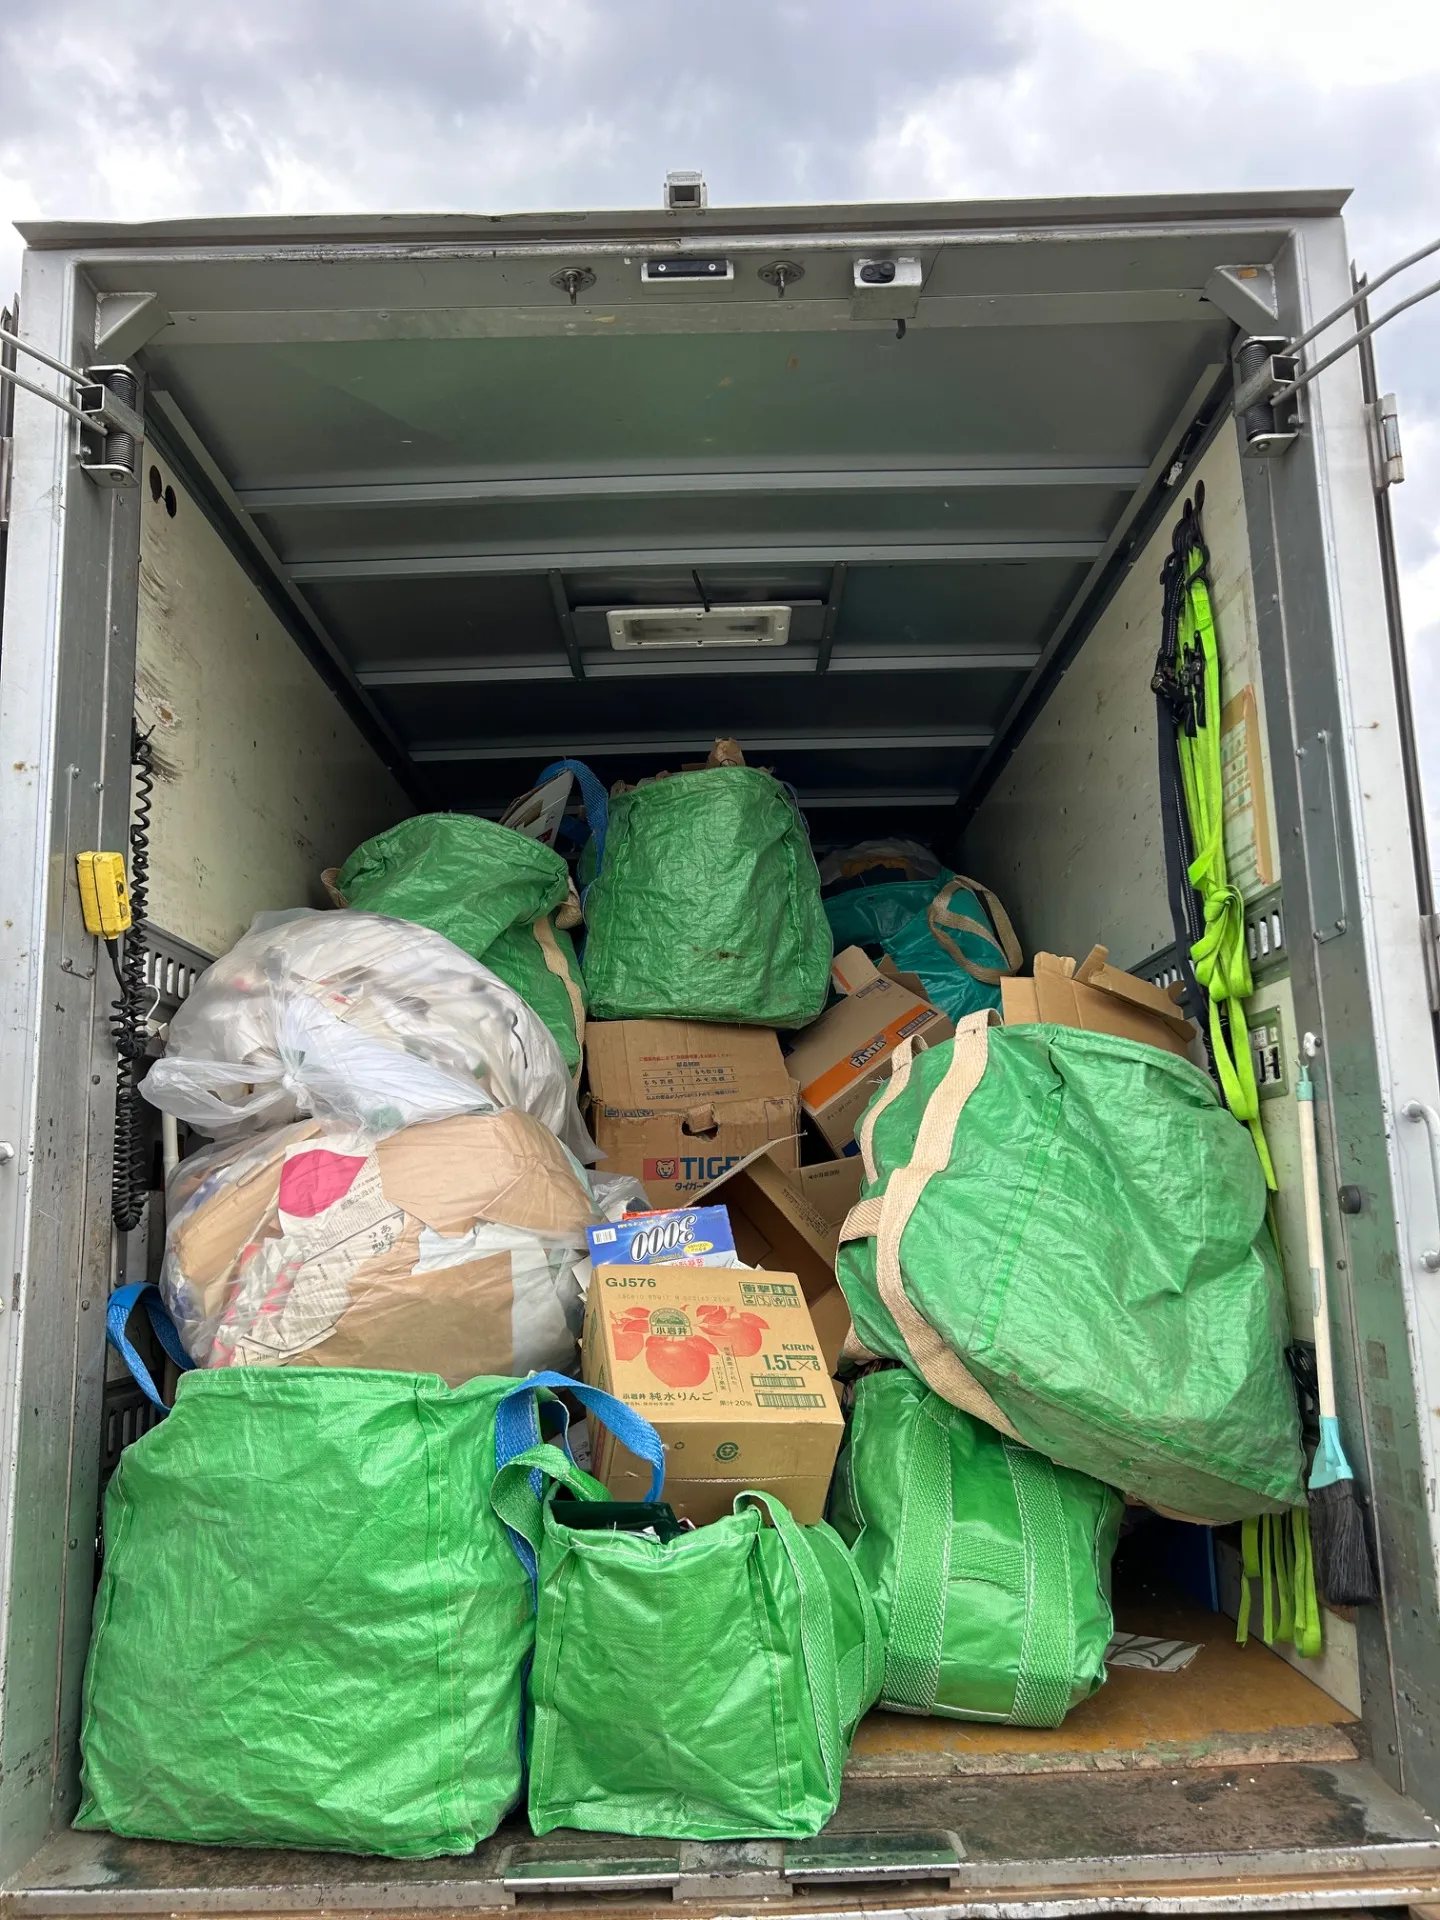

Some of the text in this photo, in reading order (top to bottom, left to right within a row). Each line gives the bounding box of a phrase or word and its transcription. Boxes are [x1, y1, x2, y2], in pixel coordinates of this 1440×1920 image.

[850, 1040, 887, 1069] FANTA
[680, 1156, 746, 1180] TIGE
[631, 1214, 698, 1263] 3000
[605, 1277, 657, 1288] GJ576
[656, 1327, 688, 1336] 小岩井
[782, 1343, 815, 1351] KIRIN
[649, 1391, 714, 1402] 純水りんご
